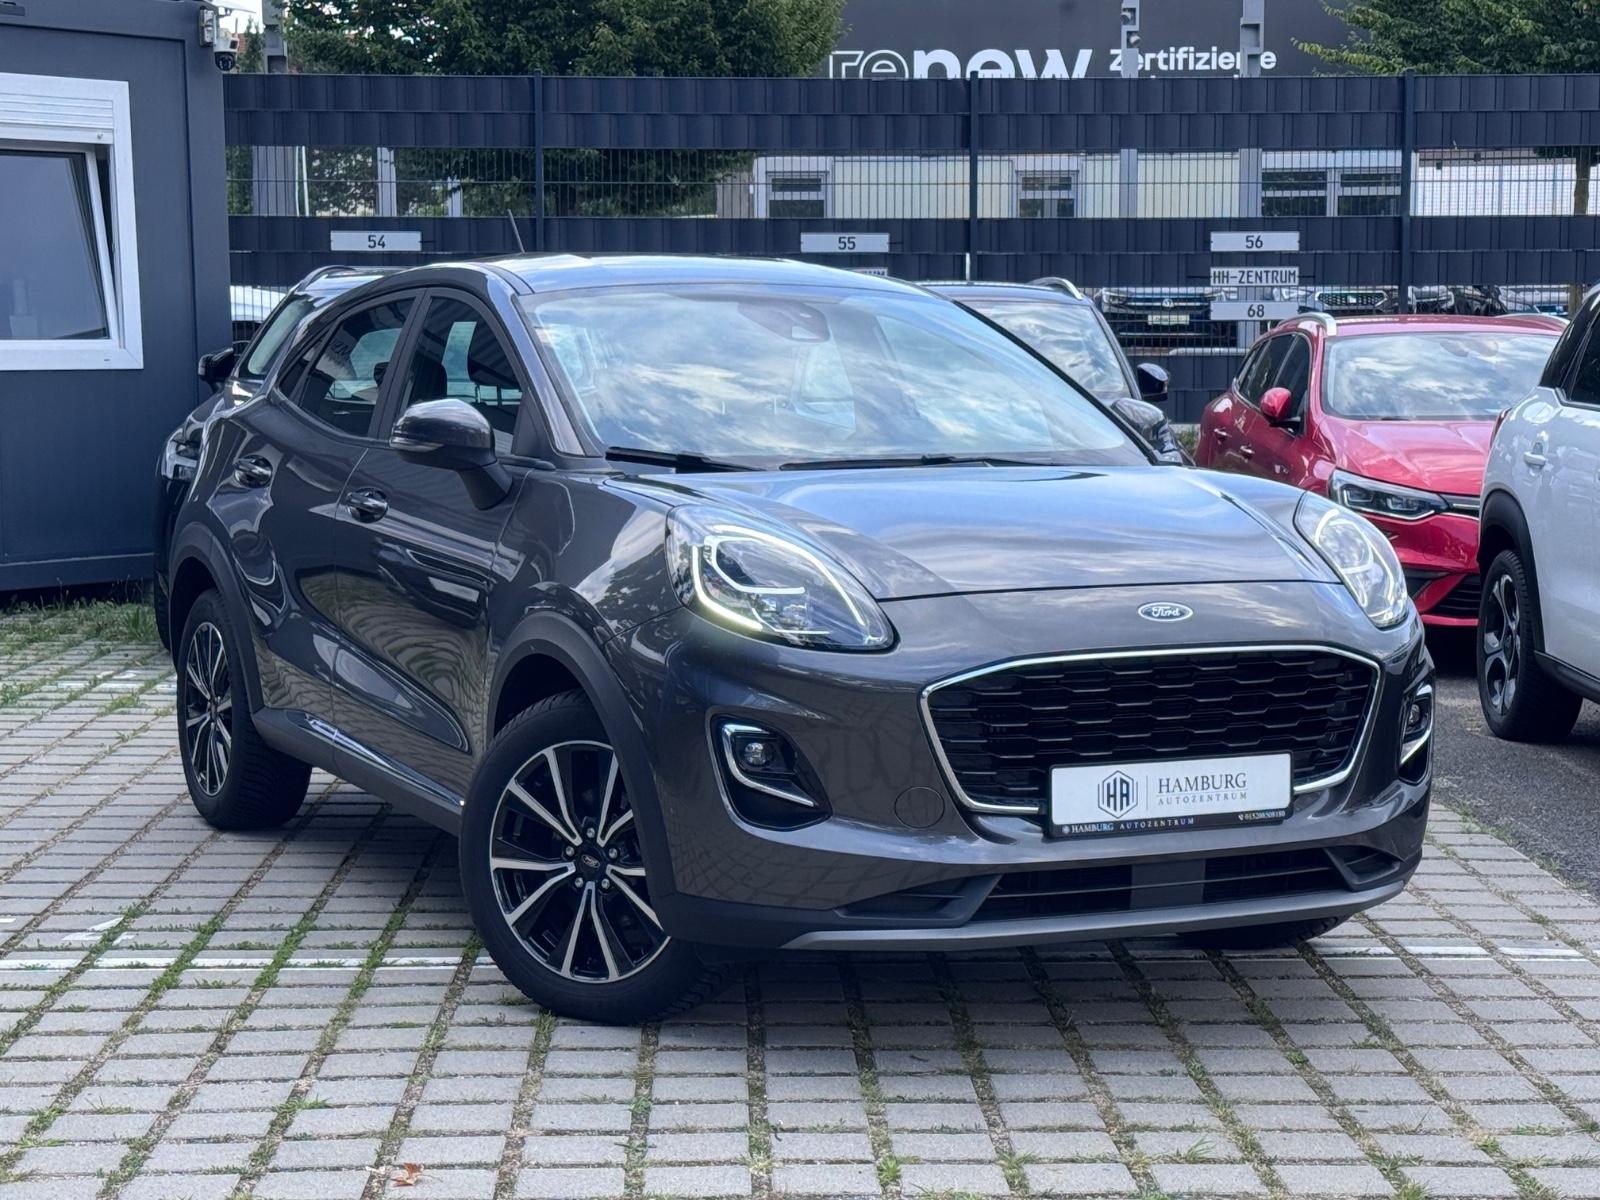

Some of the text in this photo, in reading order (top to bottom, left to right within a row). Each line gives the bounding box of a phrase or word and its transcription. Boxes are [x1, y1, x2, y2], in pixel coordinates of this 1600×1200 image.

[367, 234, 386, 249] 54
[838, 236, 856, 250] 55
[1245, 235, 1263, 249] 56
[1213, 270, 1296, 284] HH-ZENTRUM
[1247, 304, 1265, 318] 68
[1151, 606, 1180, 617] Ford
[1158, 772, 1247, 794] HAMBURG
[1158, 792, 1248, 806] AUTOZENTRUM
[1071, 817, 1194, 834] HAMBURG AUTOZENTRUM
